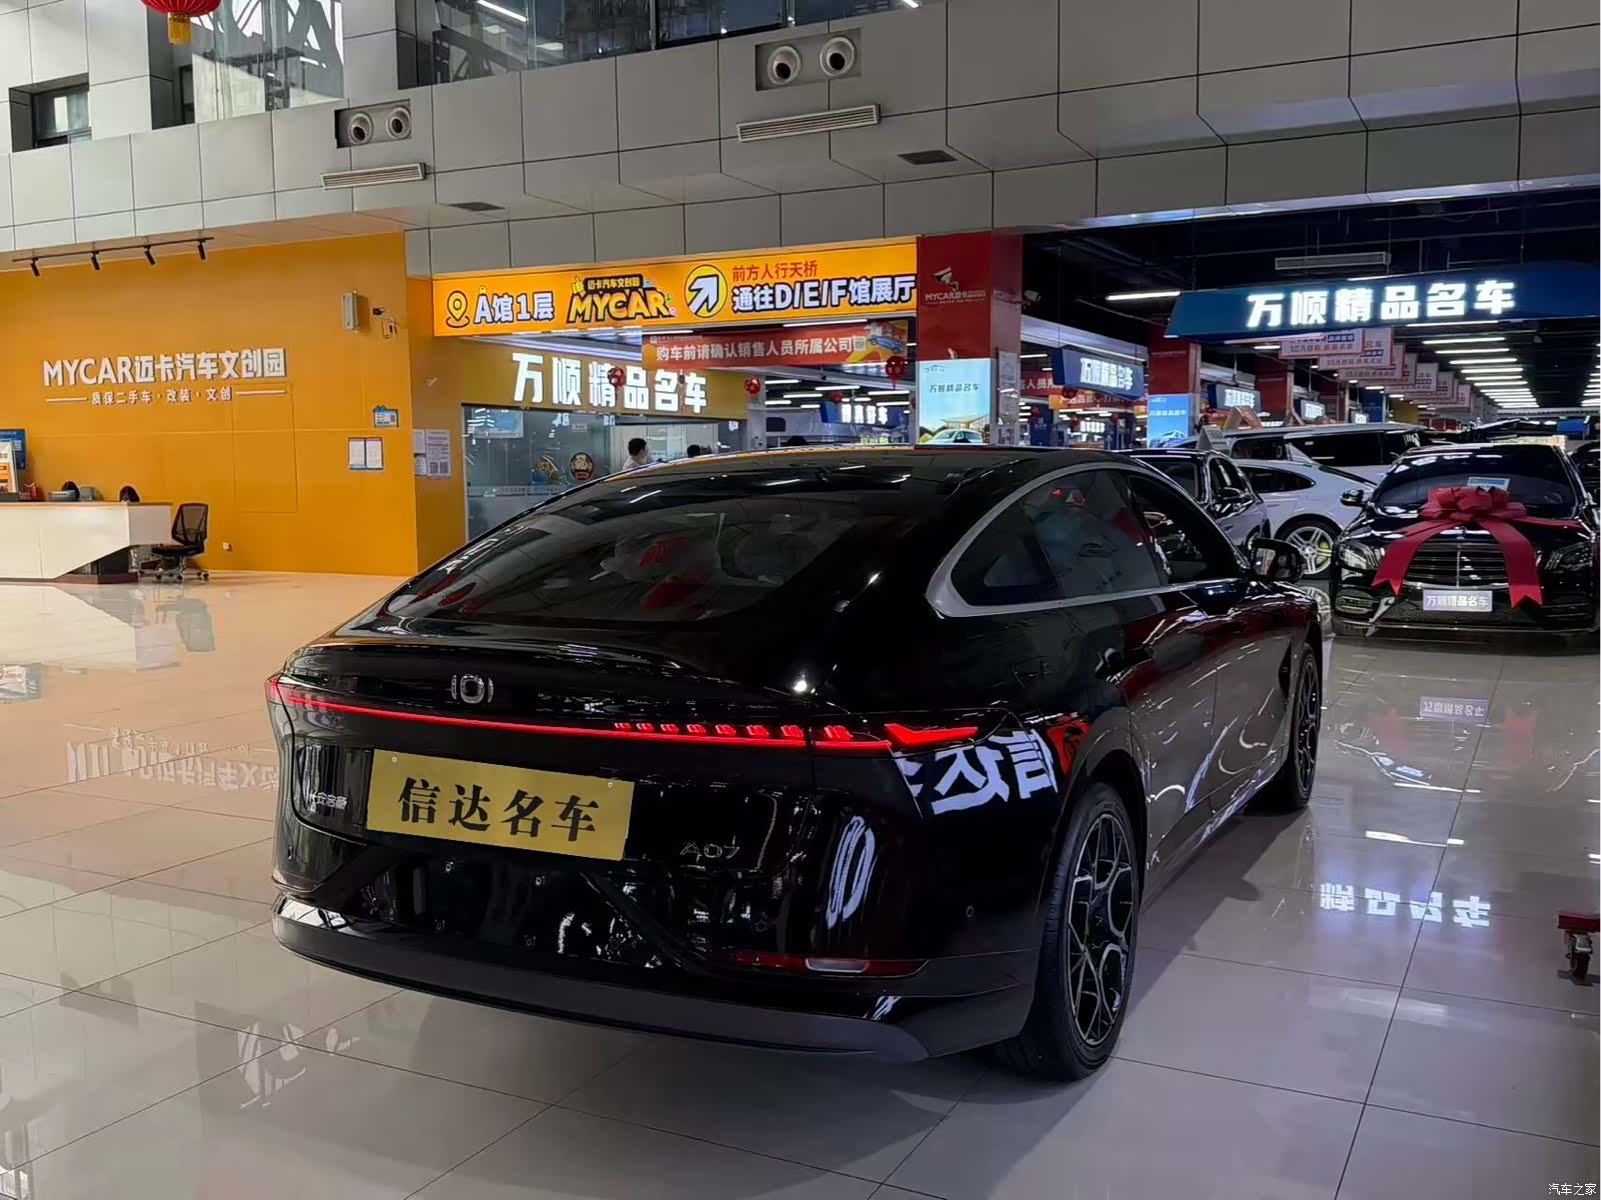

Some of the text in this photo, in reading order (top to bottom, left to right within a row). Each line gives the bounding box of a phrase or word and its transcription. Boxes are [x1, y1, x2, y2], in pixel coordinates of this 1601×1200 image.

[732, 260, 818, 282] 前方人行天桥
[567, 289, 672, 323] MYCAR
[733, 275, 916, 313] 通往D/E/F馆展厅
[1246, 280, 1518, 328] 万顺精品名车
[43, 347, 287, 386] MYCAR迈卡汽车文创园
[656, 336, 854, 361] 购车前请确认销售人员所属公司
[512, 352, 707, 414] 万顺精品名车
[397, 777, 601, 842] 信达名车
